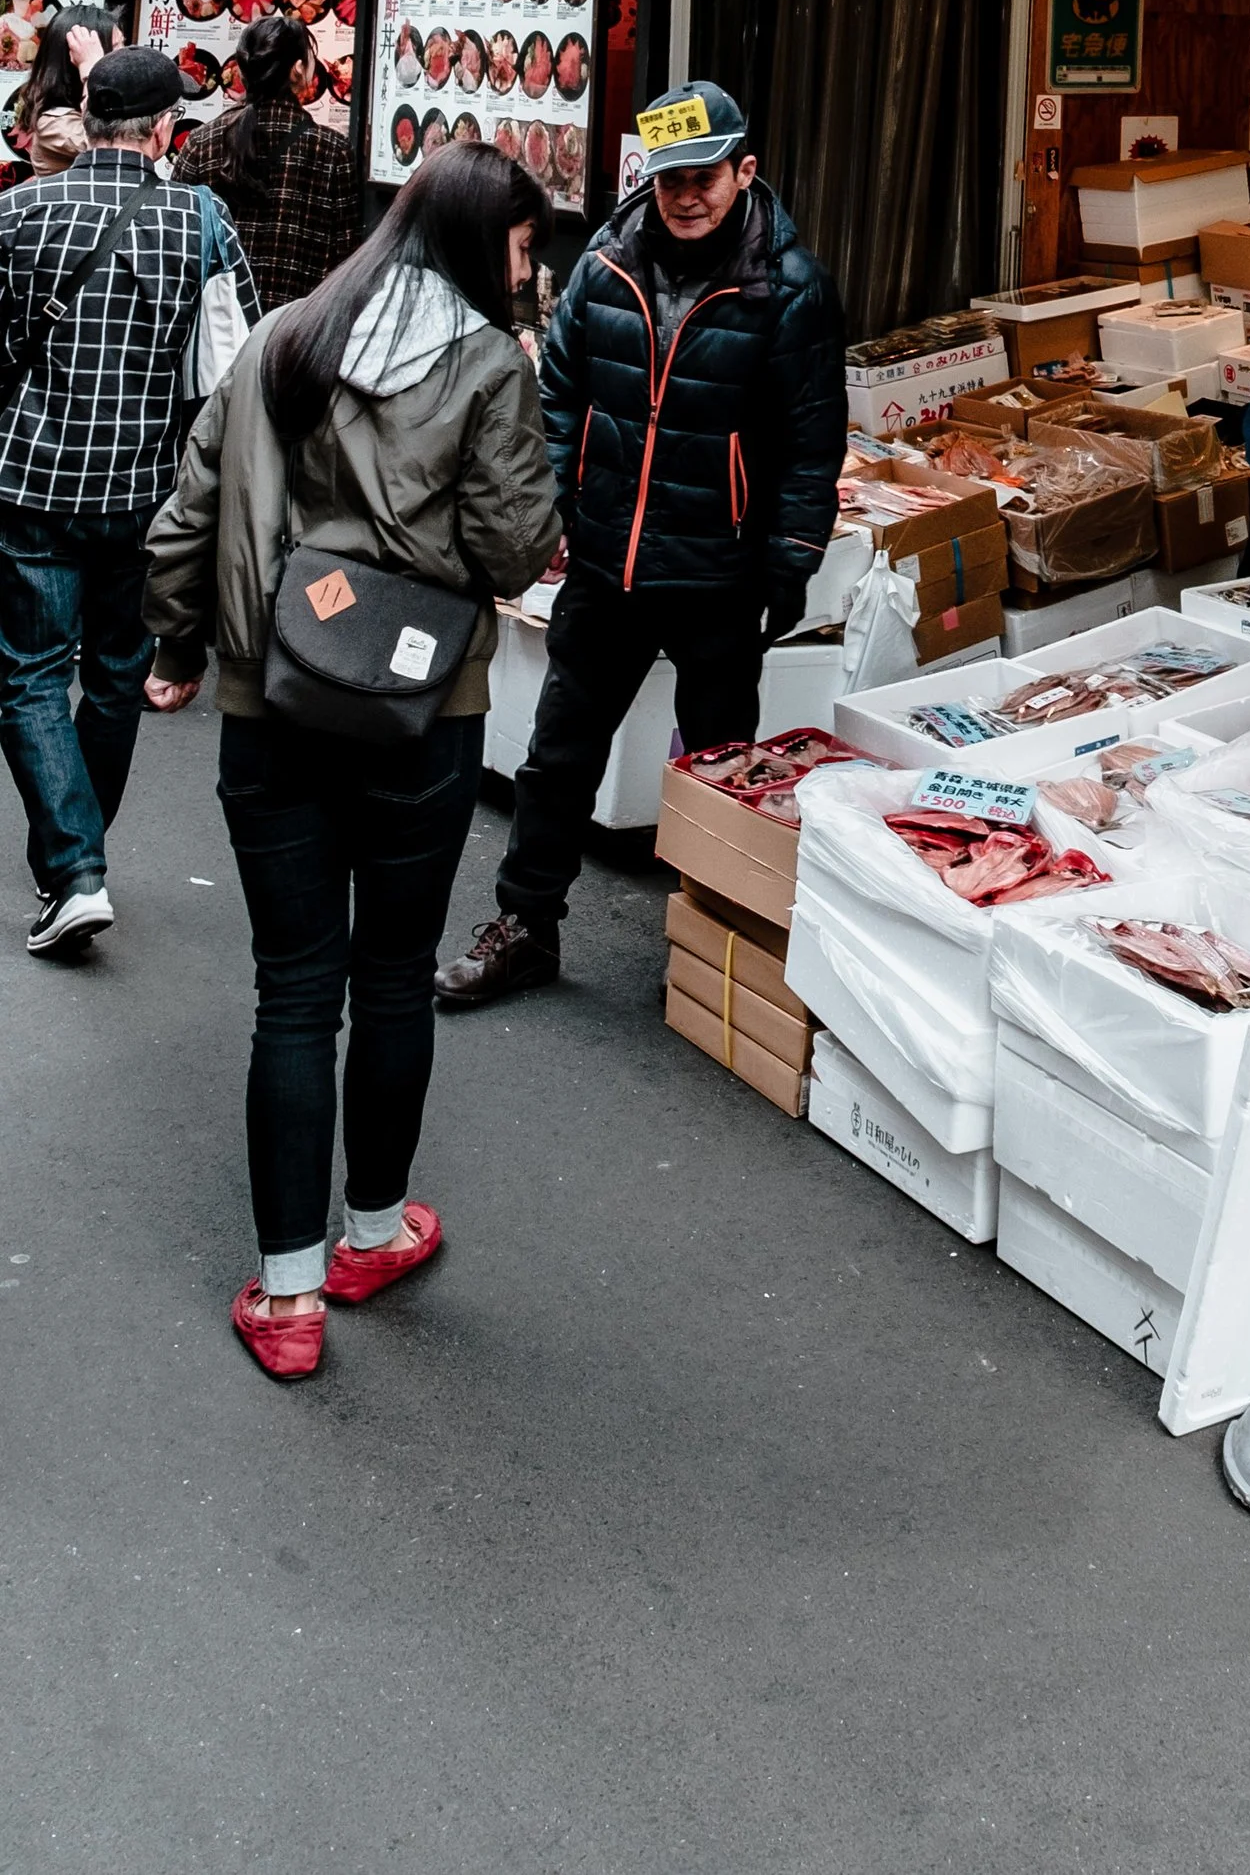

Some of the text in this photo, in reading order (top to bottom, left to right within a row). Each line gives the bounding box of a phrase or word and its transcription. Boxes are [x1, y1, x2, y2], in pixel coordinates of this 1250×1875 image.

[1061, 32, 1129, 58] 宅急便
[918, 377, 985, 405] 九十九里浜特産
[926, 782, 1024, 807] 金目開き 特大
[934, 771, 1028, 796] 青森・宮城県産
